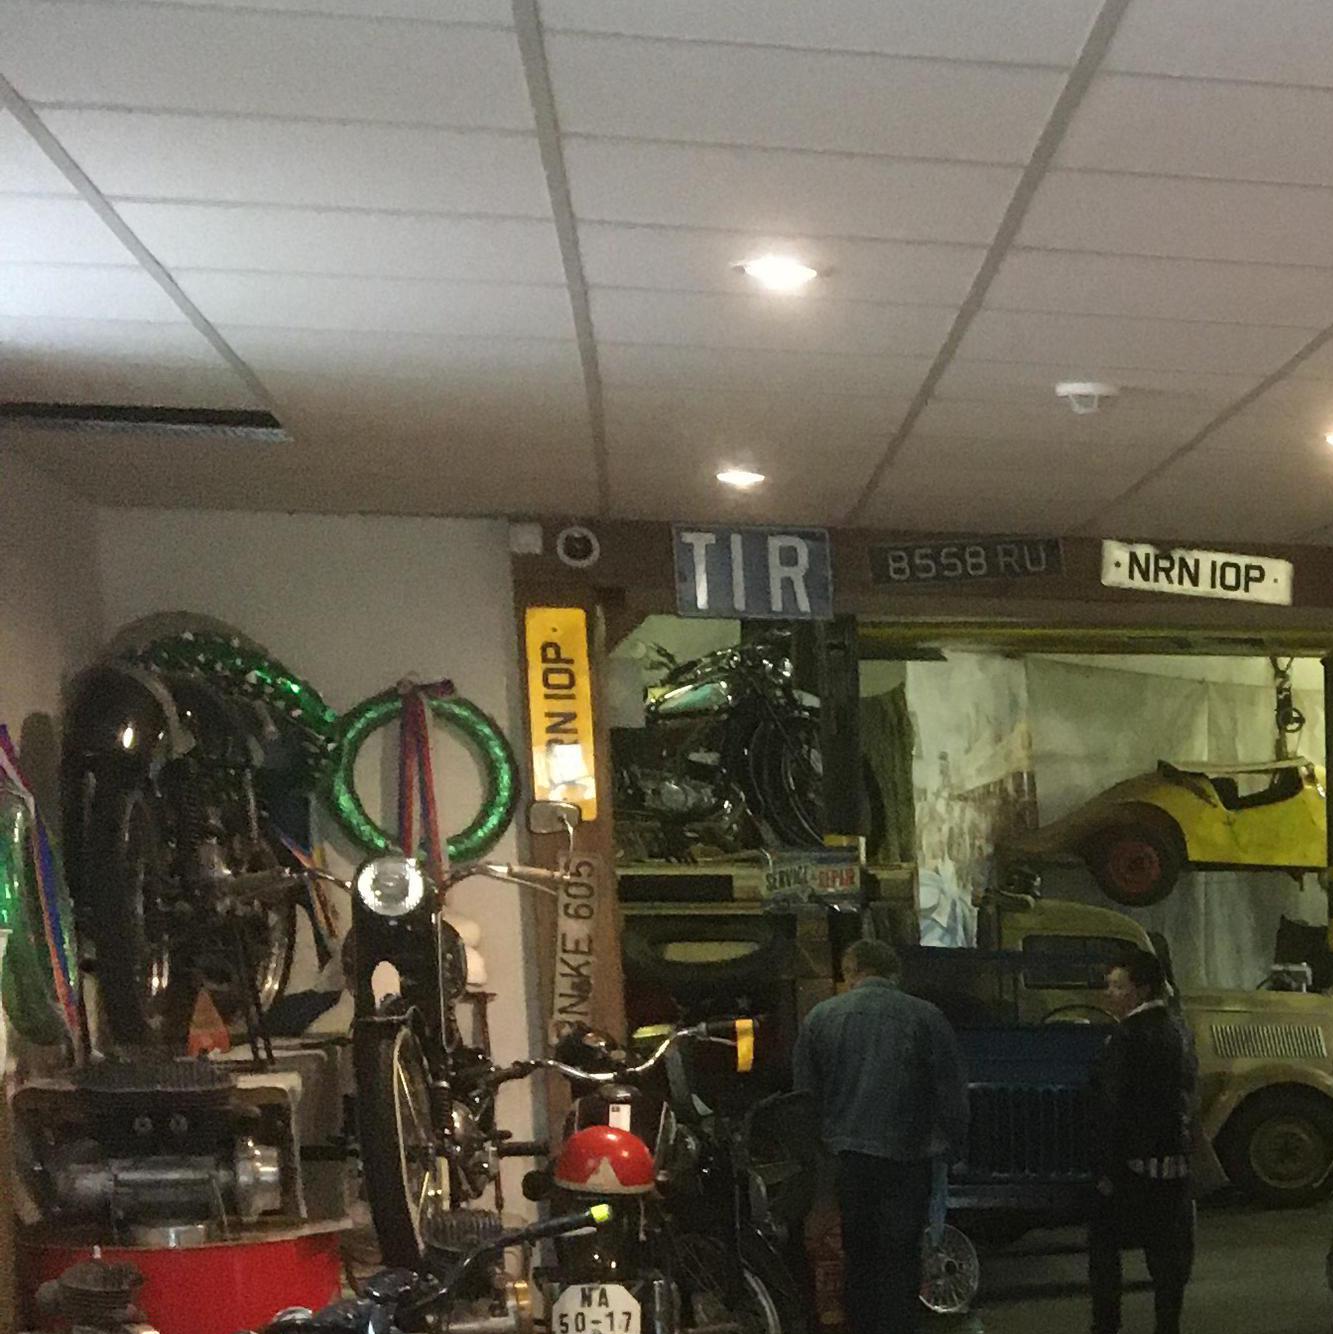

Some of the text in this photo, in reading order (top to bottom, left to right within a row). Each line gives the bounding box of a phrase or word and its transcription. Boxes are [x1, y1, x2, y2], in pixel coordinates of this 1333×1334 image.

[681, 532, 811, 612] TIR
[997, 544, 1046, 574] RU
[1128, 551, 1200, 587] NRN
[563, 860, 595, 920] 605
[560, 933, 593, 978] KE
[559, 1311, 632, 1333] 50-17
